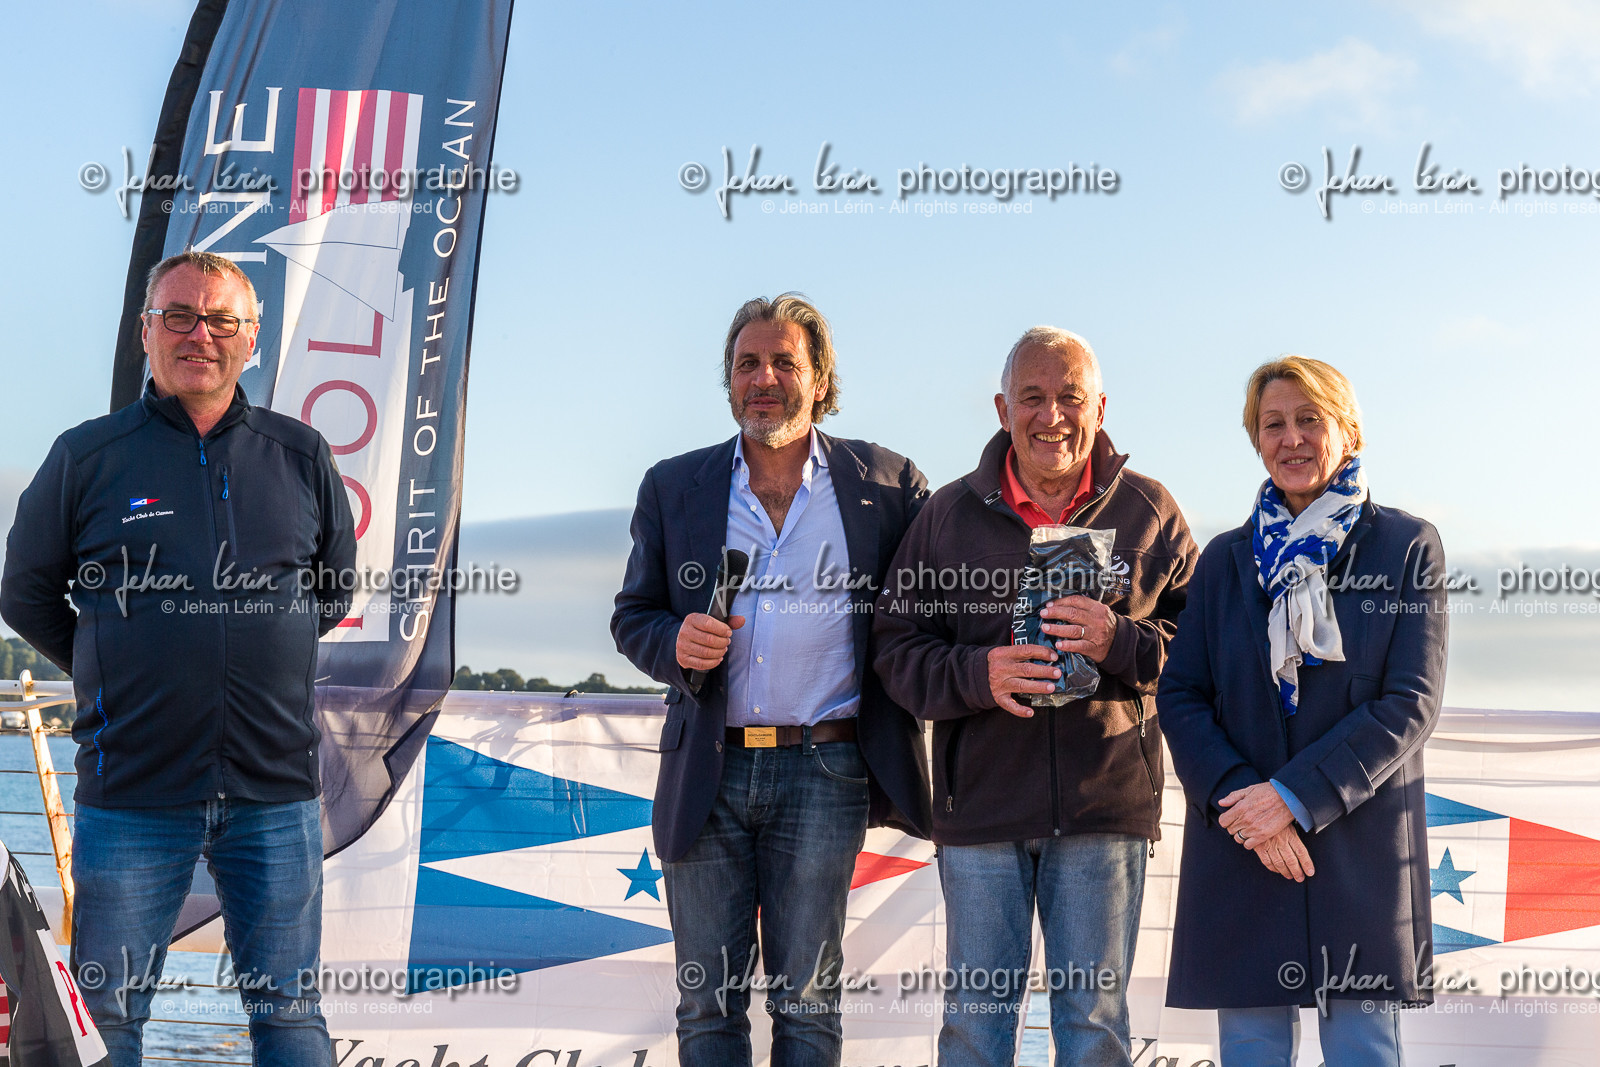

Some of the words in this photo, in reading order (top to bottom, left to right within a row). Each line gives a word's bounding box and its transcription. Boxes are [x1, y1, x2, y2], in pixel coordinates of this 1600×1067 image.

[433, 98, 476, 258] OCEAN
[420, 277, 450, 375] THE
[413, 396, 438, 456] OF
[400, 478, 436, 641] SPIRIT
